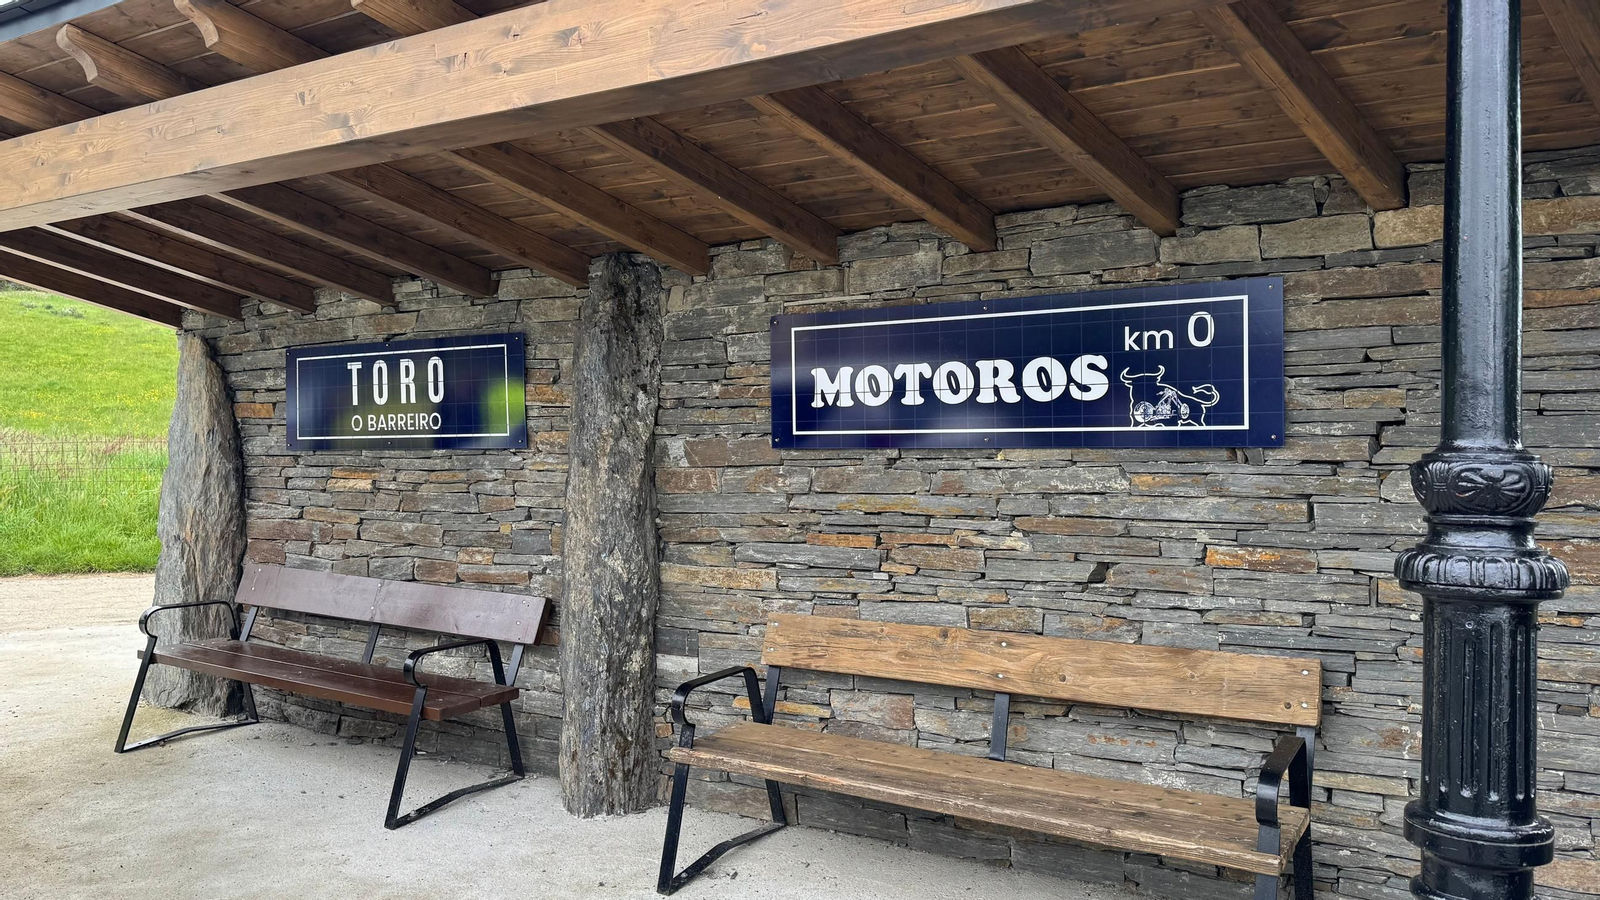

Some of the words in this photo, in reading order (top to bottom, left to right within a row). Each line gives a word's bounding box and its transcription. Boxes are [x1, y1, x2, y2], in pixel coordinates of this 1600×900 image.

[1124, 326, 1174, 351] km
[1187, 310, 1215, 348] 0
[347, 356, 445, 406] TORO
[810, 354, 1109, 408] MOTOROS
[351, 414, 363, 432] O
[367, 412, 442, 431] BARREIRO
